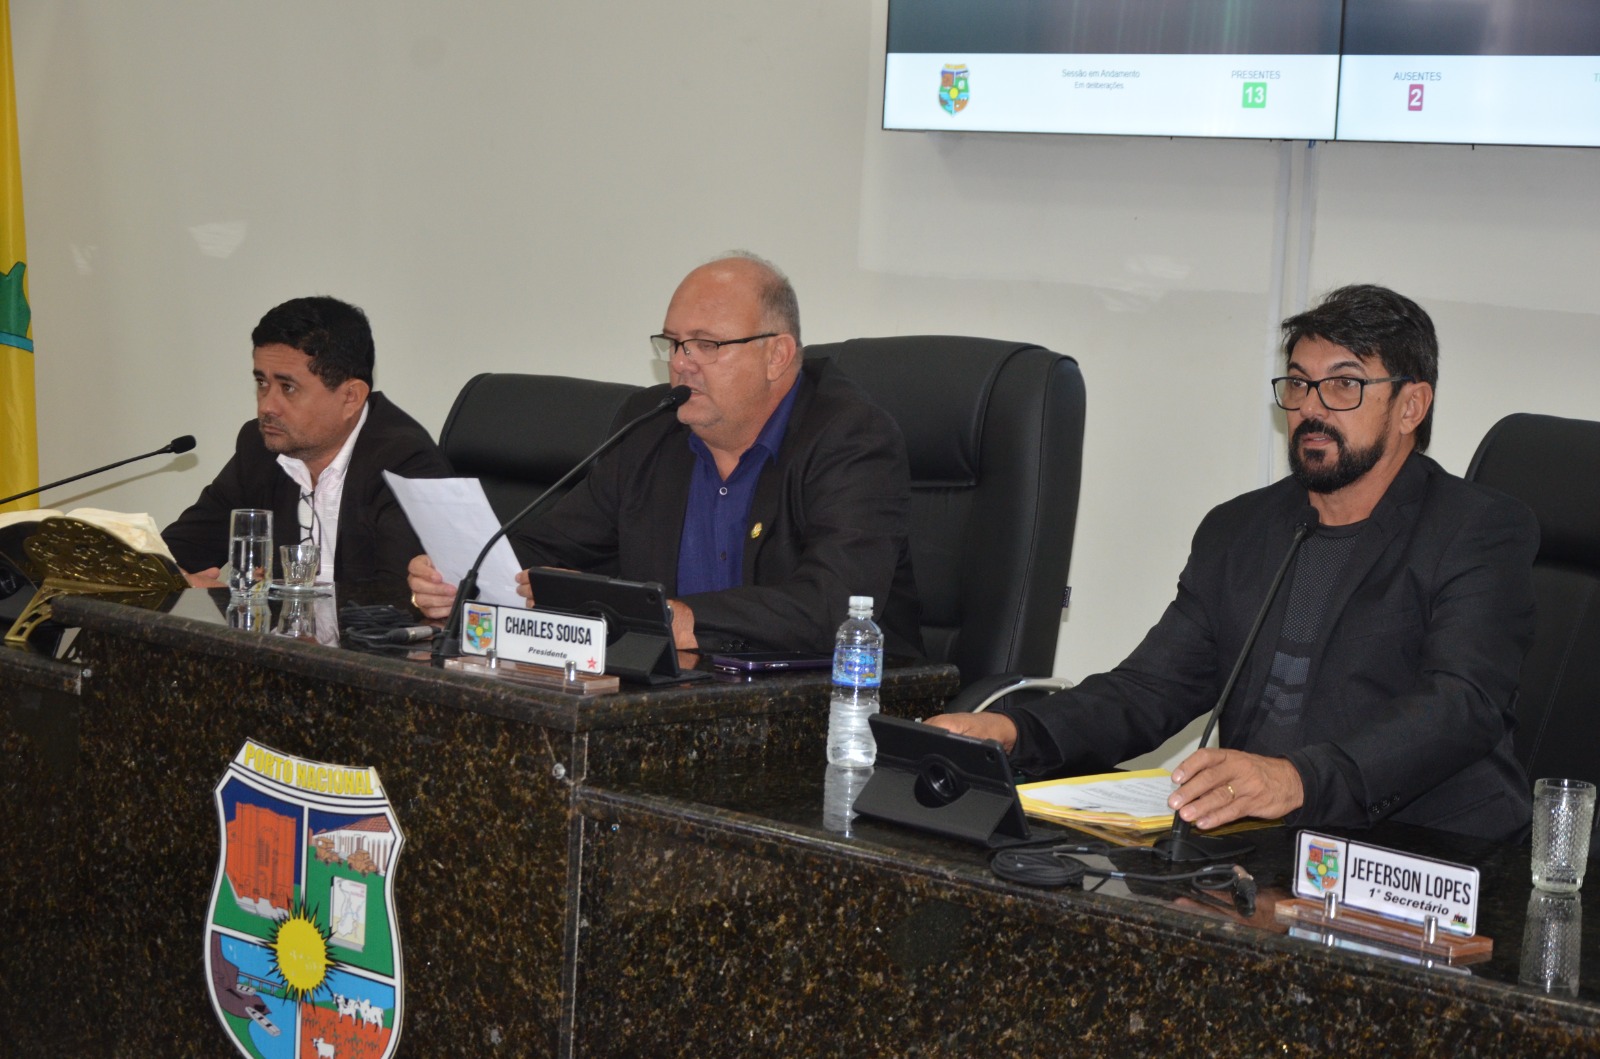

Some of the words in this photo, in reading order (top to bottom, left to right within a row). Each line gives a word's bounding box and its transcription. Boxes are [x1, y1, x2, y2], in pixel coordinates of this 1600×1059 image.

[1062, 69, 1087, 78] Sessão
[1088, 70, 1099, 78] em
[1101, 69, 1141, 78] Andamento
[1231, 70, 1281, 80] PRESENTES
[1393, 71, 1442, 81] AUSENTES
[1074, 81, 1085, 89] Em
[1245, 86, 1265, 104] 13
[1409, 88, 1422, 107] 2
[505, 616, 554, 640] CHARLES
[556, 624, 592, 646] SOUSA
[528, 646, 568, 660] Presidente
[243, 742, 294, 784] PORTO
[296, 762, 374, 796] NACIONAL
[1350, 857, 1422, 894] JEFERSON
[1425, 874, 1472, 906] LOPES
[1383, 891, 1450, 916] Secretário
